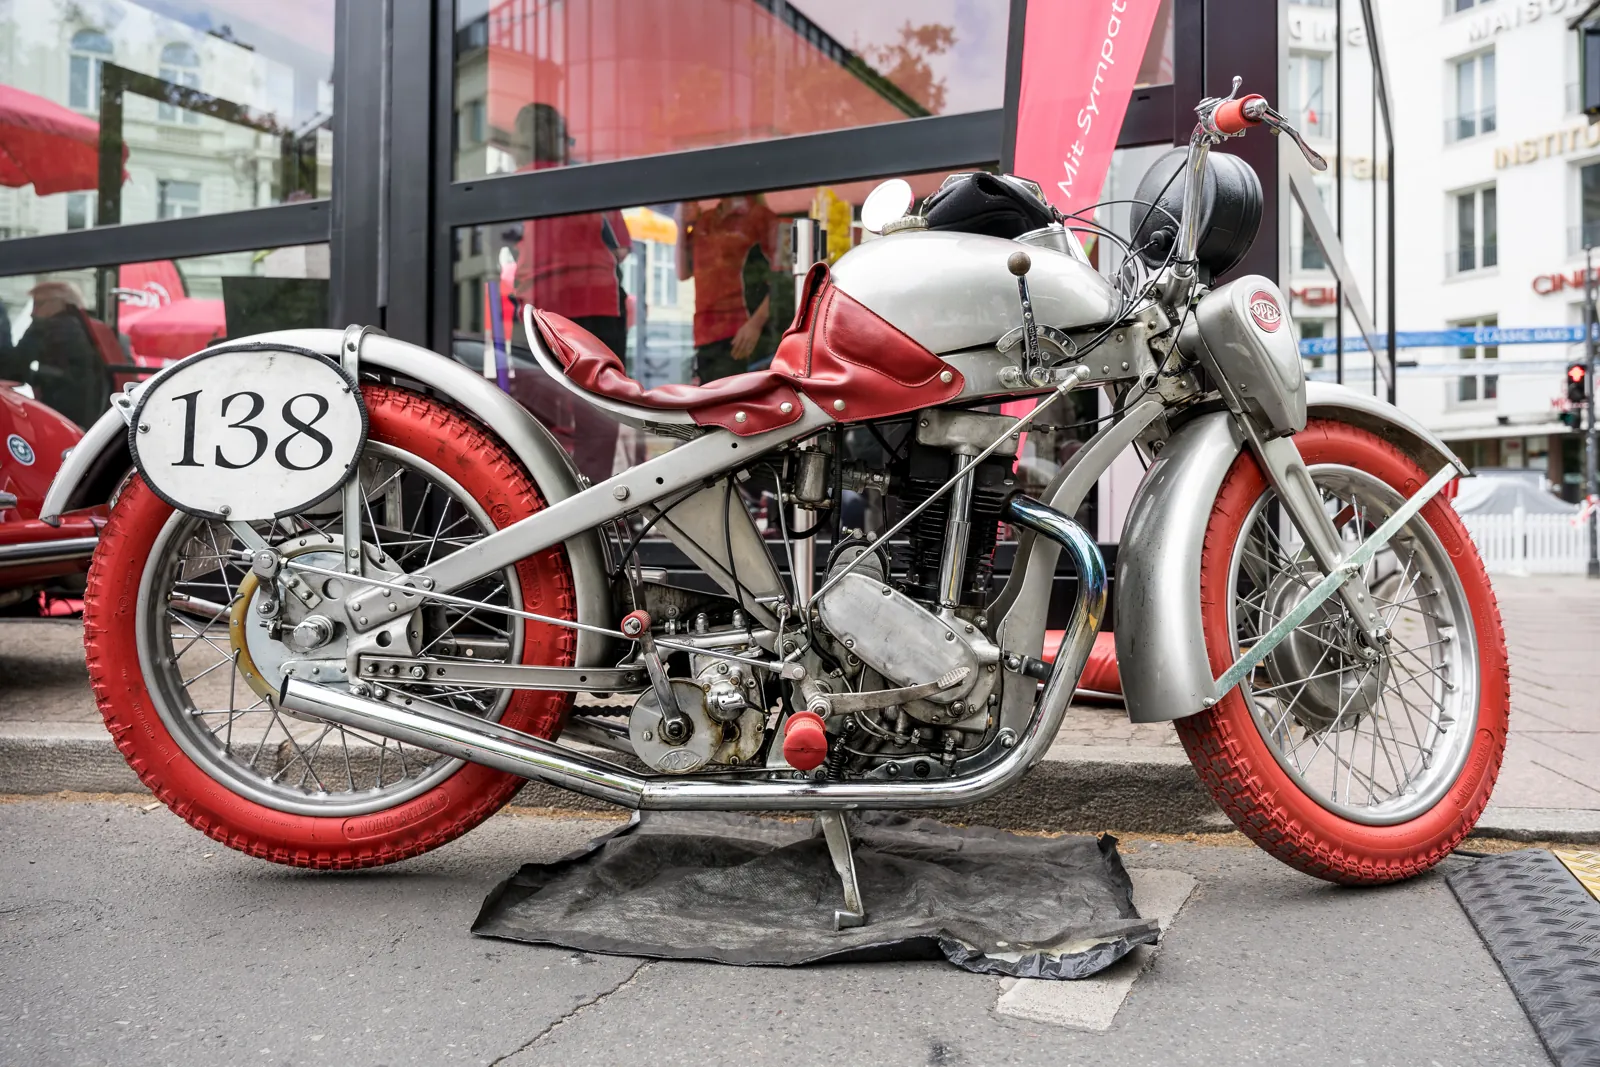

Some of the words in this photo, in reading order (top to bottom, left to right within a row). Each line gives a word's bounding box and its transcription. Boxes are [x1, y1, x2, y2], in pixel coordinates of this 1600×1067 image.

[1469, 0, 1584, 42] MAISO
[1057, 140, 1084, 198] Mit
[1077, 0, 1127, 135] Sympat
[1253, 303, 1278, 320] OPEL
[171, 389, 333, 471] 138
